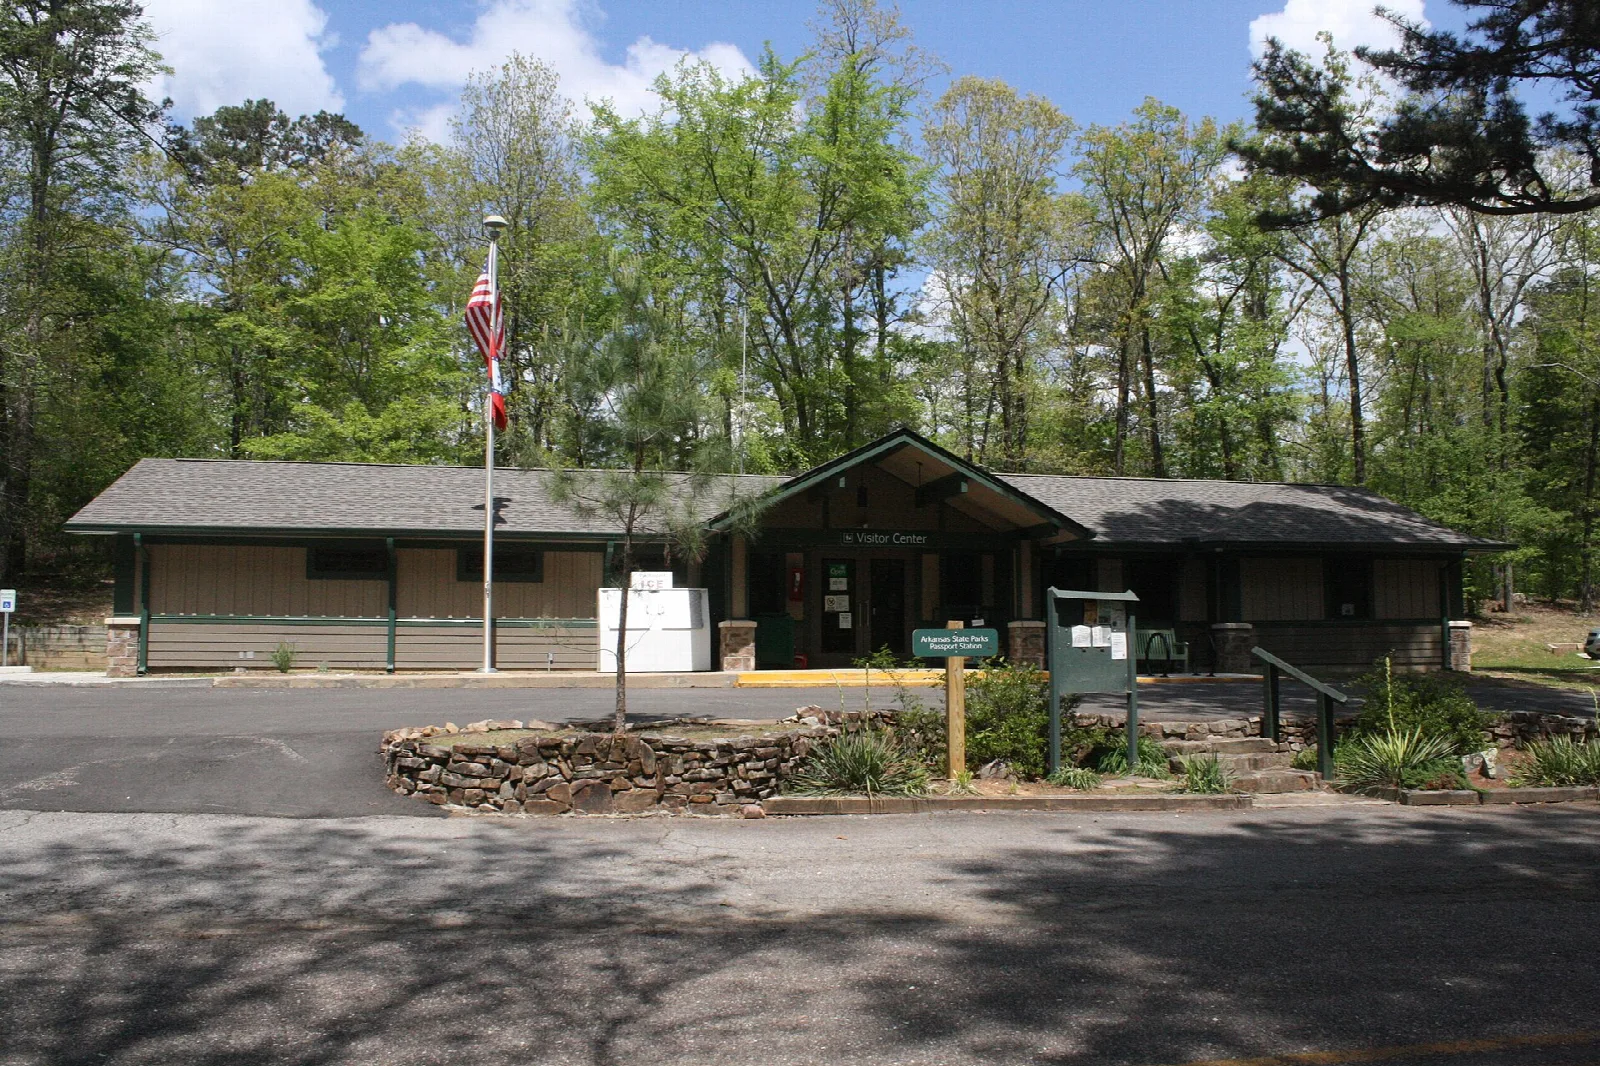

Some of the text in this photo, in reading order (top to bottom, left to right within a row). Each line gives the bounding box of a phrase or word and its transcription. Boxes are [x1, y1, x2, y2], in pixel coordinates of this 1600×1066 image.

[856, 532, 927, 544] Visitor Center
[640, 580, 664, 589] ICE
[952, 635, 970, 643] State
[929, 643, 958, 651] Passport
